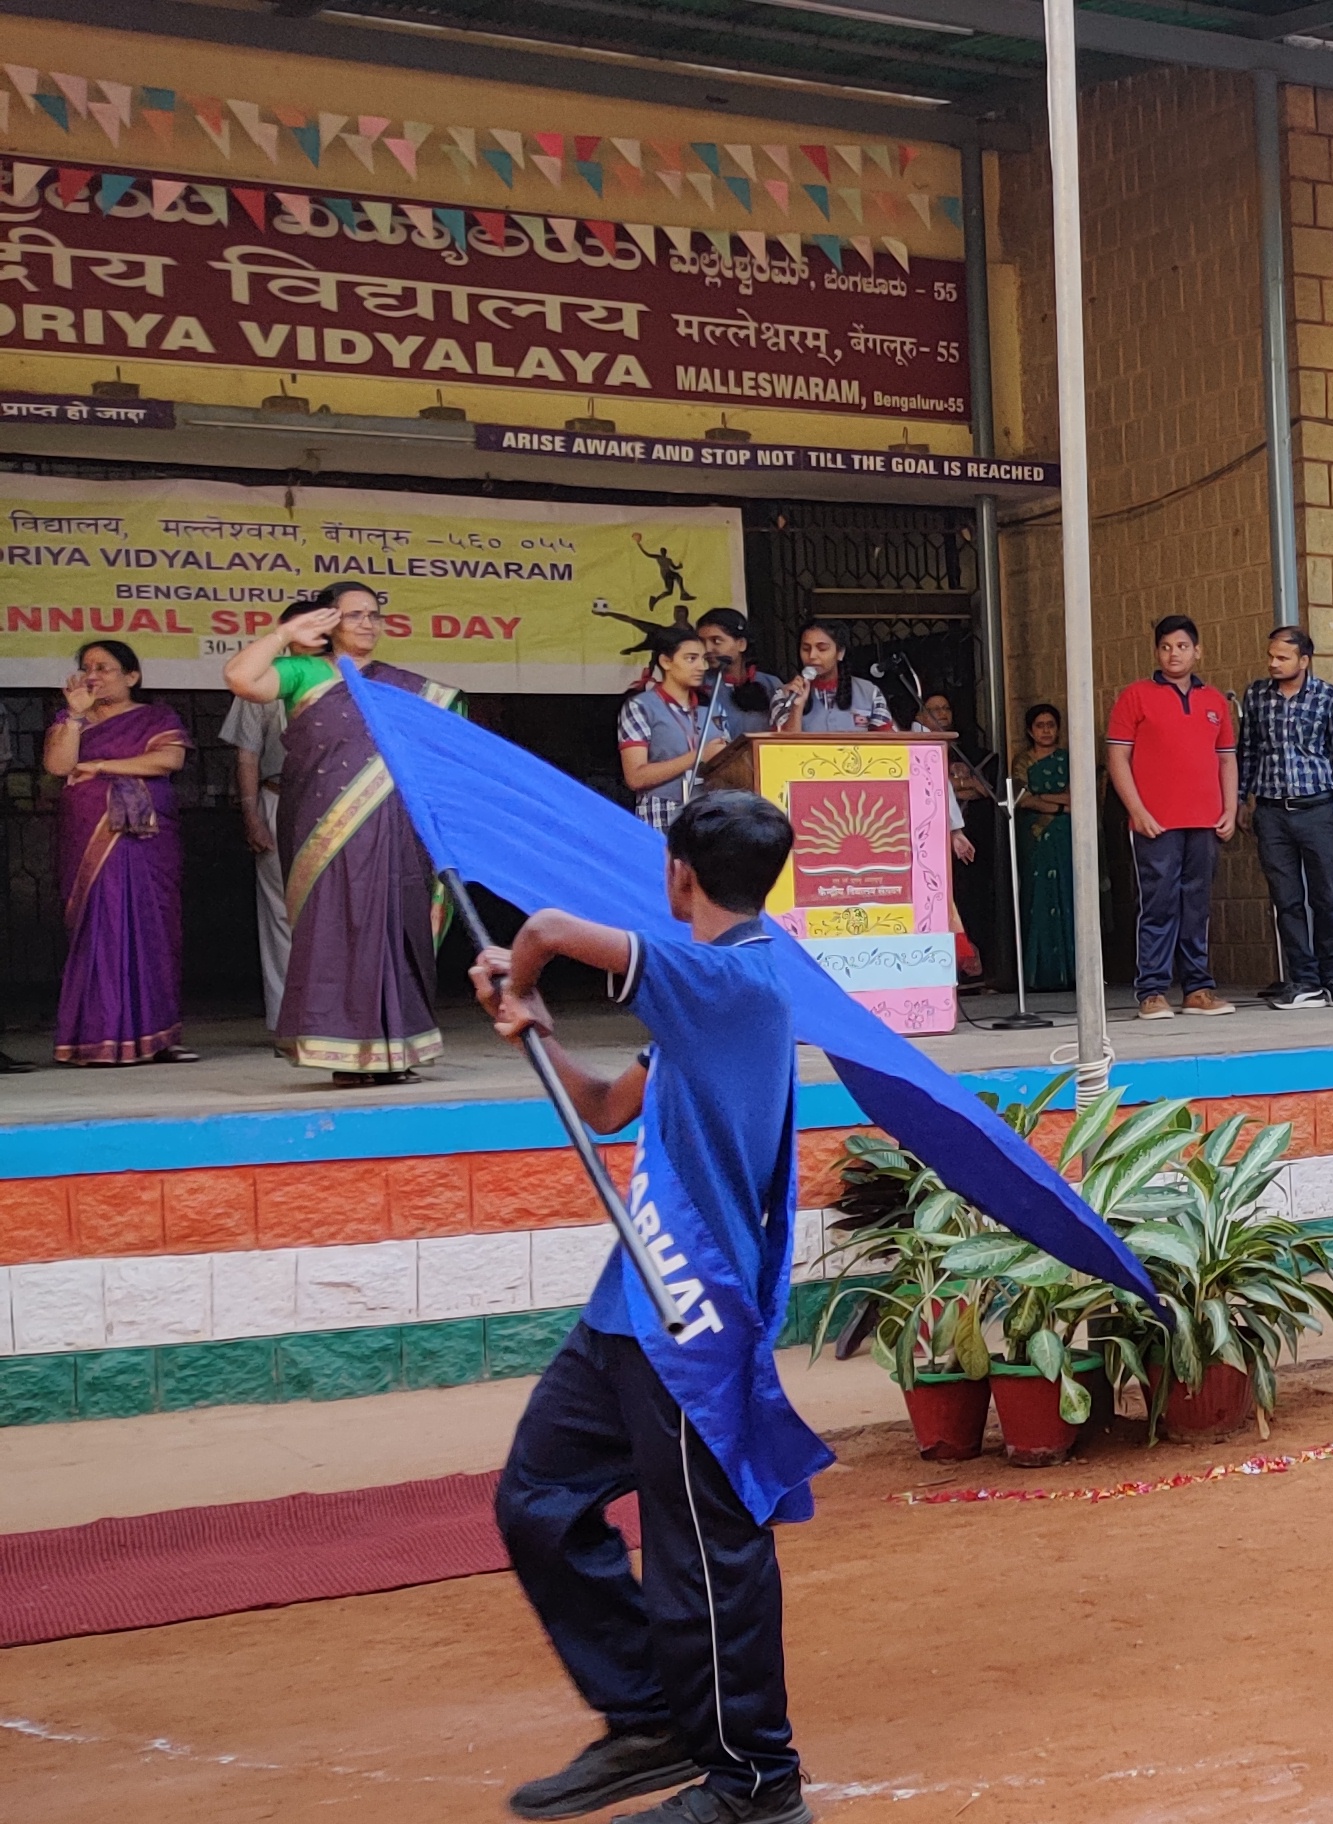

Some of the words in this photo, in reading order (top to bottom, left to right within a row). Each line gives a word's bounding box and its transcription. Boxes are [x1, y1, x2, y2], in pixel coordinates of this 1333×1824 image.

[207, 244, 651, 341] विद्यालय
[937, 341, 960, 363] 55
[934, 282, 958, 302] 55
[238, 320, 652, 389] VIDYALAYA
[675, 364, 866, 410] MALLESWARAM,
[873, 390, 964, 413] Bengaluru-55
[64, 401, 91, 420] हो
[502, 431, 567, 453] ARISE
[572, 438, 647, 459] AWAKE
[651, 444, 694, 463] AND
[700, 448, 750, 466] STOP
[757, 450, 795, 466] NOT
[807, 451, 846, 470] TILL
[851, 454, 886, 472] THE
[891, 456, 938, 476] GOAL
[943, 458, 962, 477] IS
[967, 462, 1045, 481] REACHED
[0, 545, 90, 566] RIYA
[100, 548, 300, 576] VIDYALAYA,
[314, 554, 573, 581] MALLESWARAM
[0, 606, 193, 634] NNUAL
[431, 615, 522, 639] DAY
